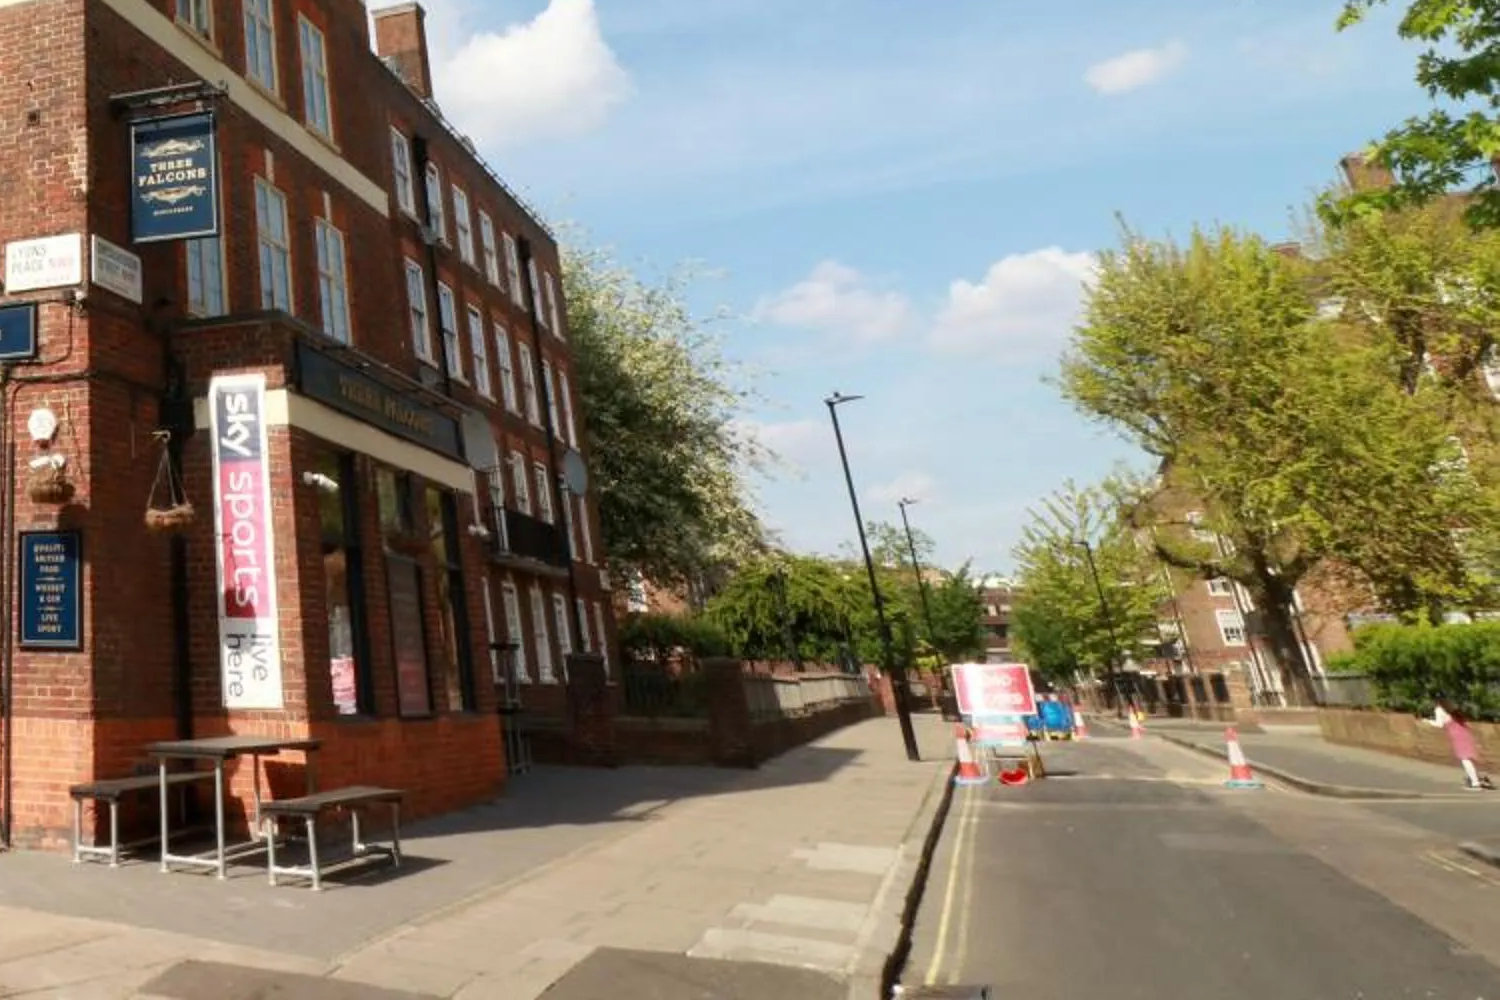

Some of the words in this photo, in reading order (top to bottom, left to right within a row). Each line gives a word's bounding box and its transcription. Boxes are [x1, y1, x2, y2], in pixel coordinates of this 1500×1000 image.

[138, 167, 207, 187] FALCONS
[150, 158, 193, 173] THREE
[220, 393, 257, 457] sky
[223, 471, 262, 608] sports
[225, 633, 247, 698] here
[250, 633, 273, 682] live
